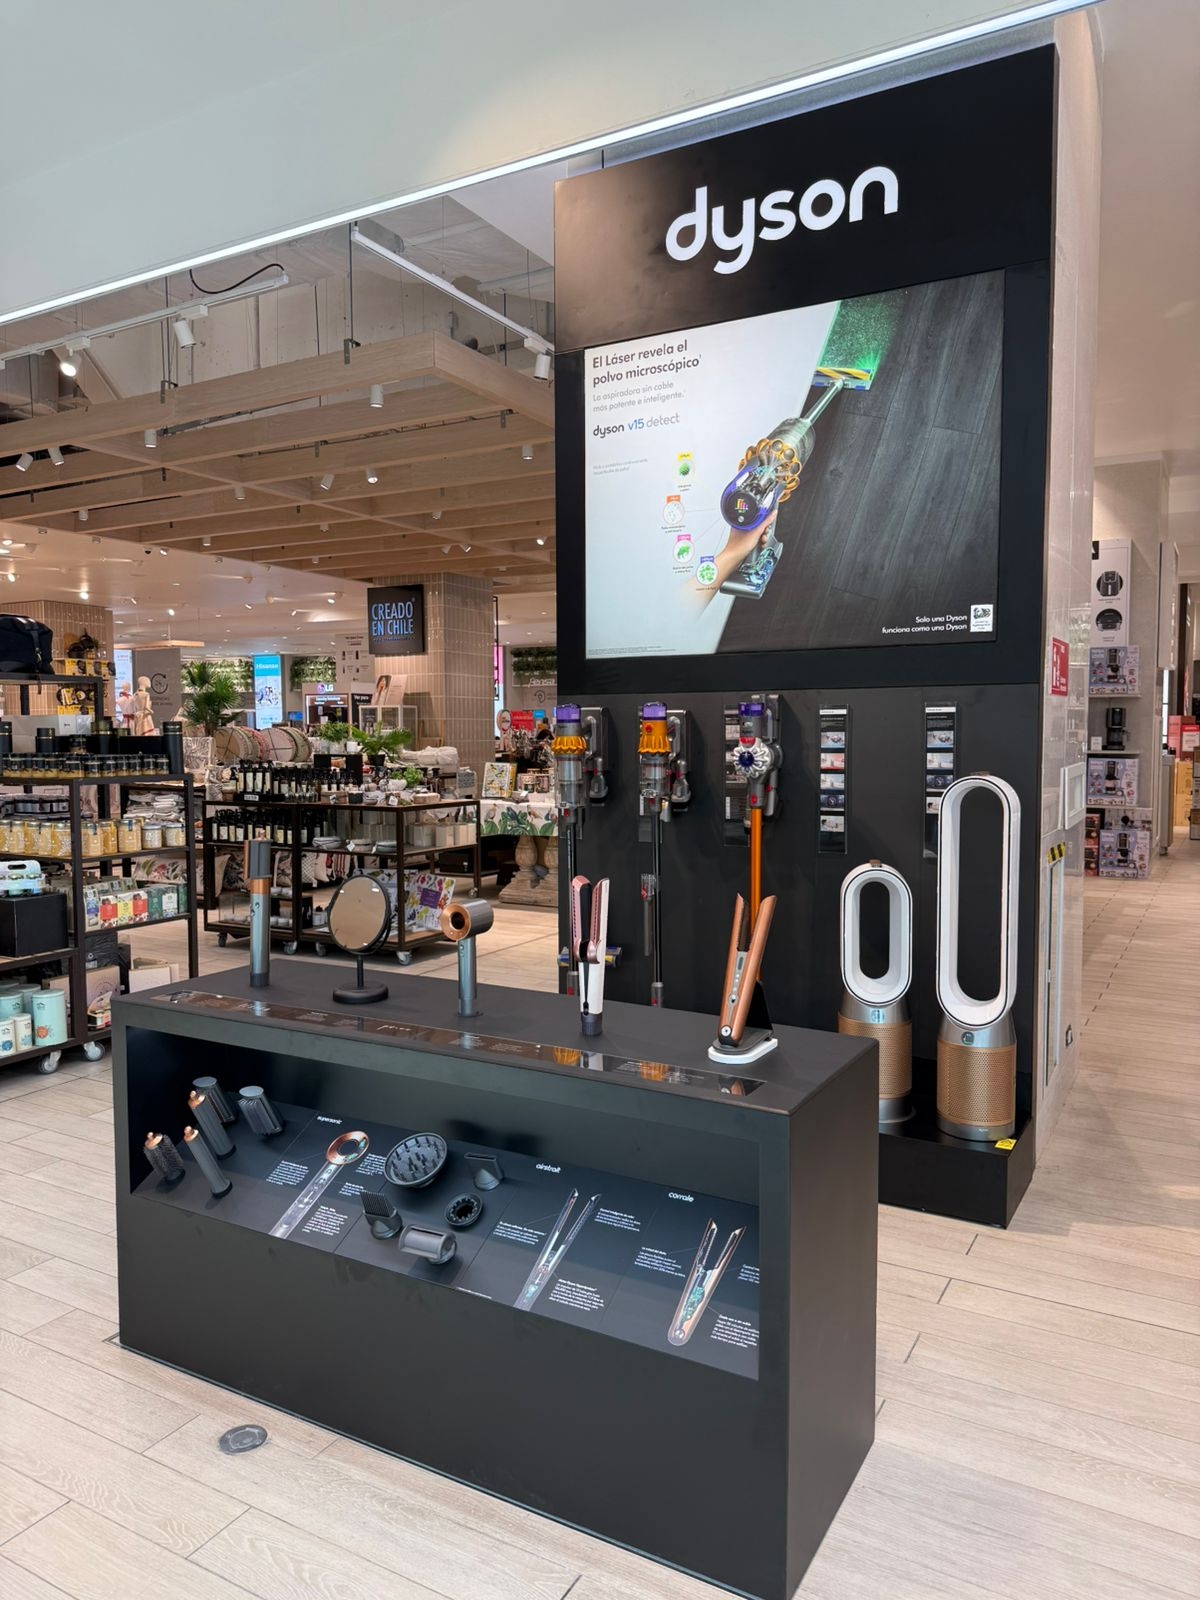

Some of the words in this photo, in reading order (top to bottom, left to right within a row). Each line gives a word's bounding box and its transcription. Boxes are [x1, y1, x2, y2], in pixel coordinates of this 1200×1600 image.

[665, 166, 899, 275] dyson
[592, 356, 603, 369] El
[605, 351, 636, 367] Láser
[638, 343, 674, 360] revela
[676, 338, 688, 353] el
[592, 371, 623, 388] polvo
[592, 393, 602, 402] La
[602, 386, 641, 401] aspiradora
[641, 383, 653, 393] sin
[653, 380, 675, 392] cable
[608, 397, 636, 412] potente
[637, 398, 643, 406] e
[592, 423, 625, 439] dyson
[627, 417, 646, 431] v15
[646, 412, 681, 428] detect
[371, 601, 414, 621] CREADO
[915, 616, 931, 624] Solo
[945, 614, 968, 623] Dyson
[372, 621, 384, 636] EN
[387, 619, 414, 635] CHILE
[881, 626, 911, 634] funciona
[945, 623, 968, 632] Dyson
[325, 684, 334, 692] LG
[668, 1191, 695, 1203] corrale
